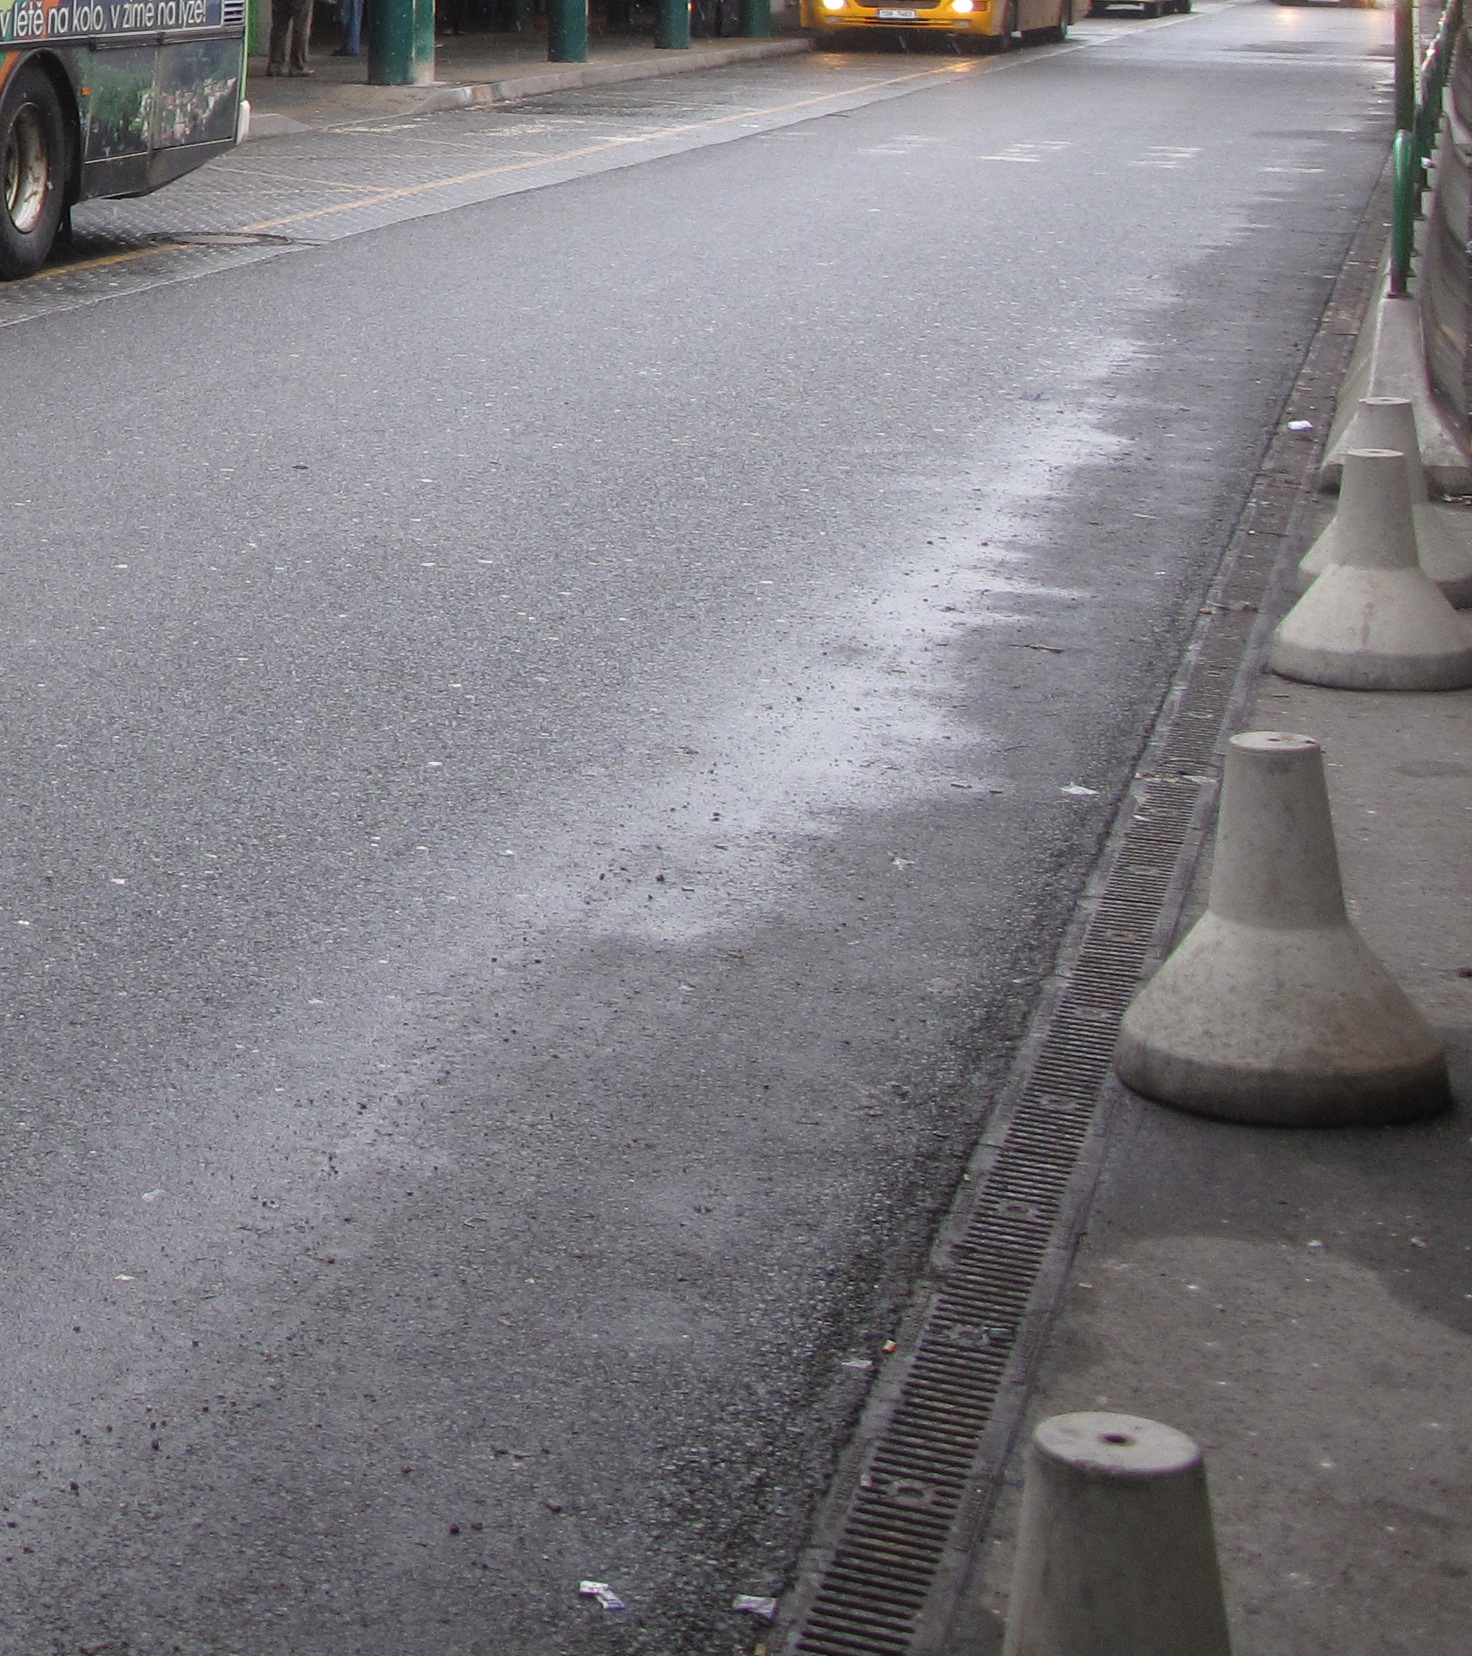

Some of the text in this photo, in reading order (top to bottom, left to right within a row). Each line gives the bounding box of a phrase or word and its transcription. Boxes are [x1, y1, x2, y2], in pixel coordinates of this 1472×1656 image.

[0, 10, 10, 37] v
[13, 1, 44, 36] létě
[48, 7, 70, 34] na
[73, 0, 107, 32] kolo,
[111, 4, 121, 28] v
[157, 1, 176, 25] na
